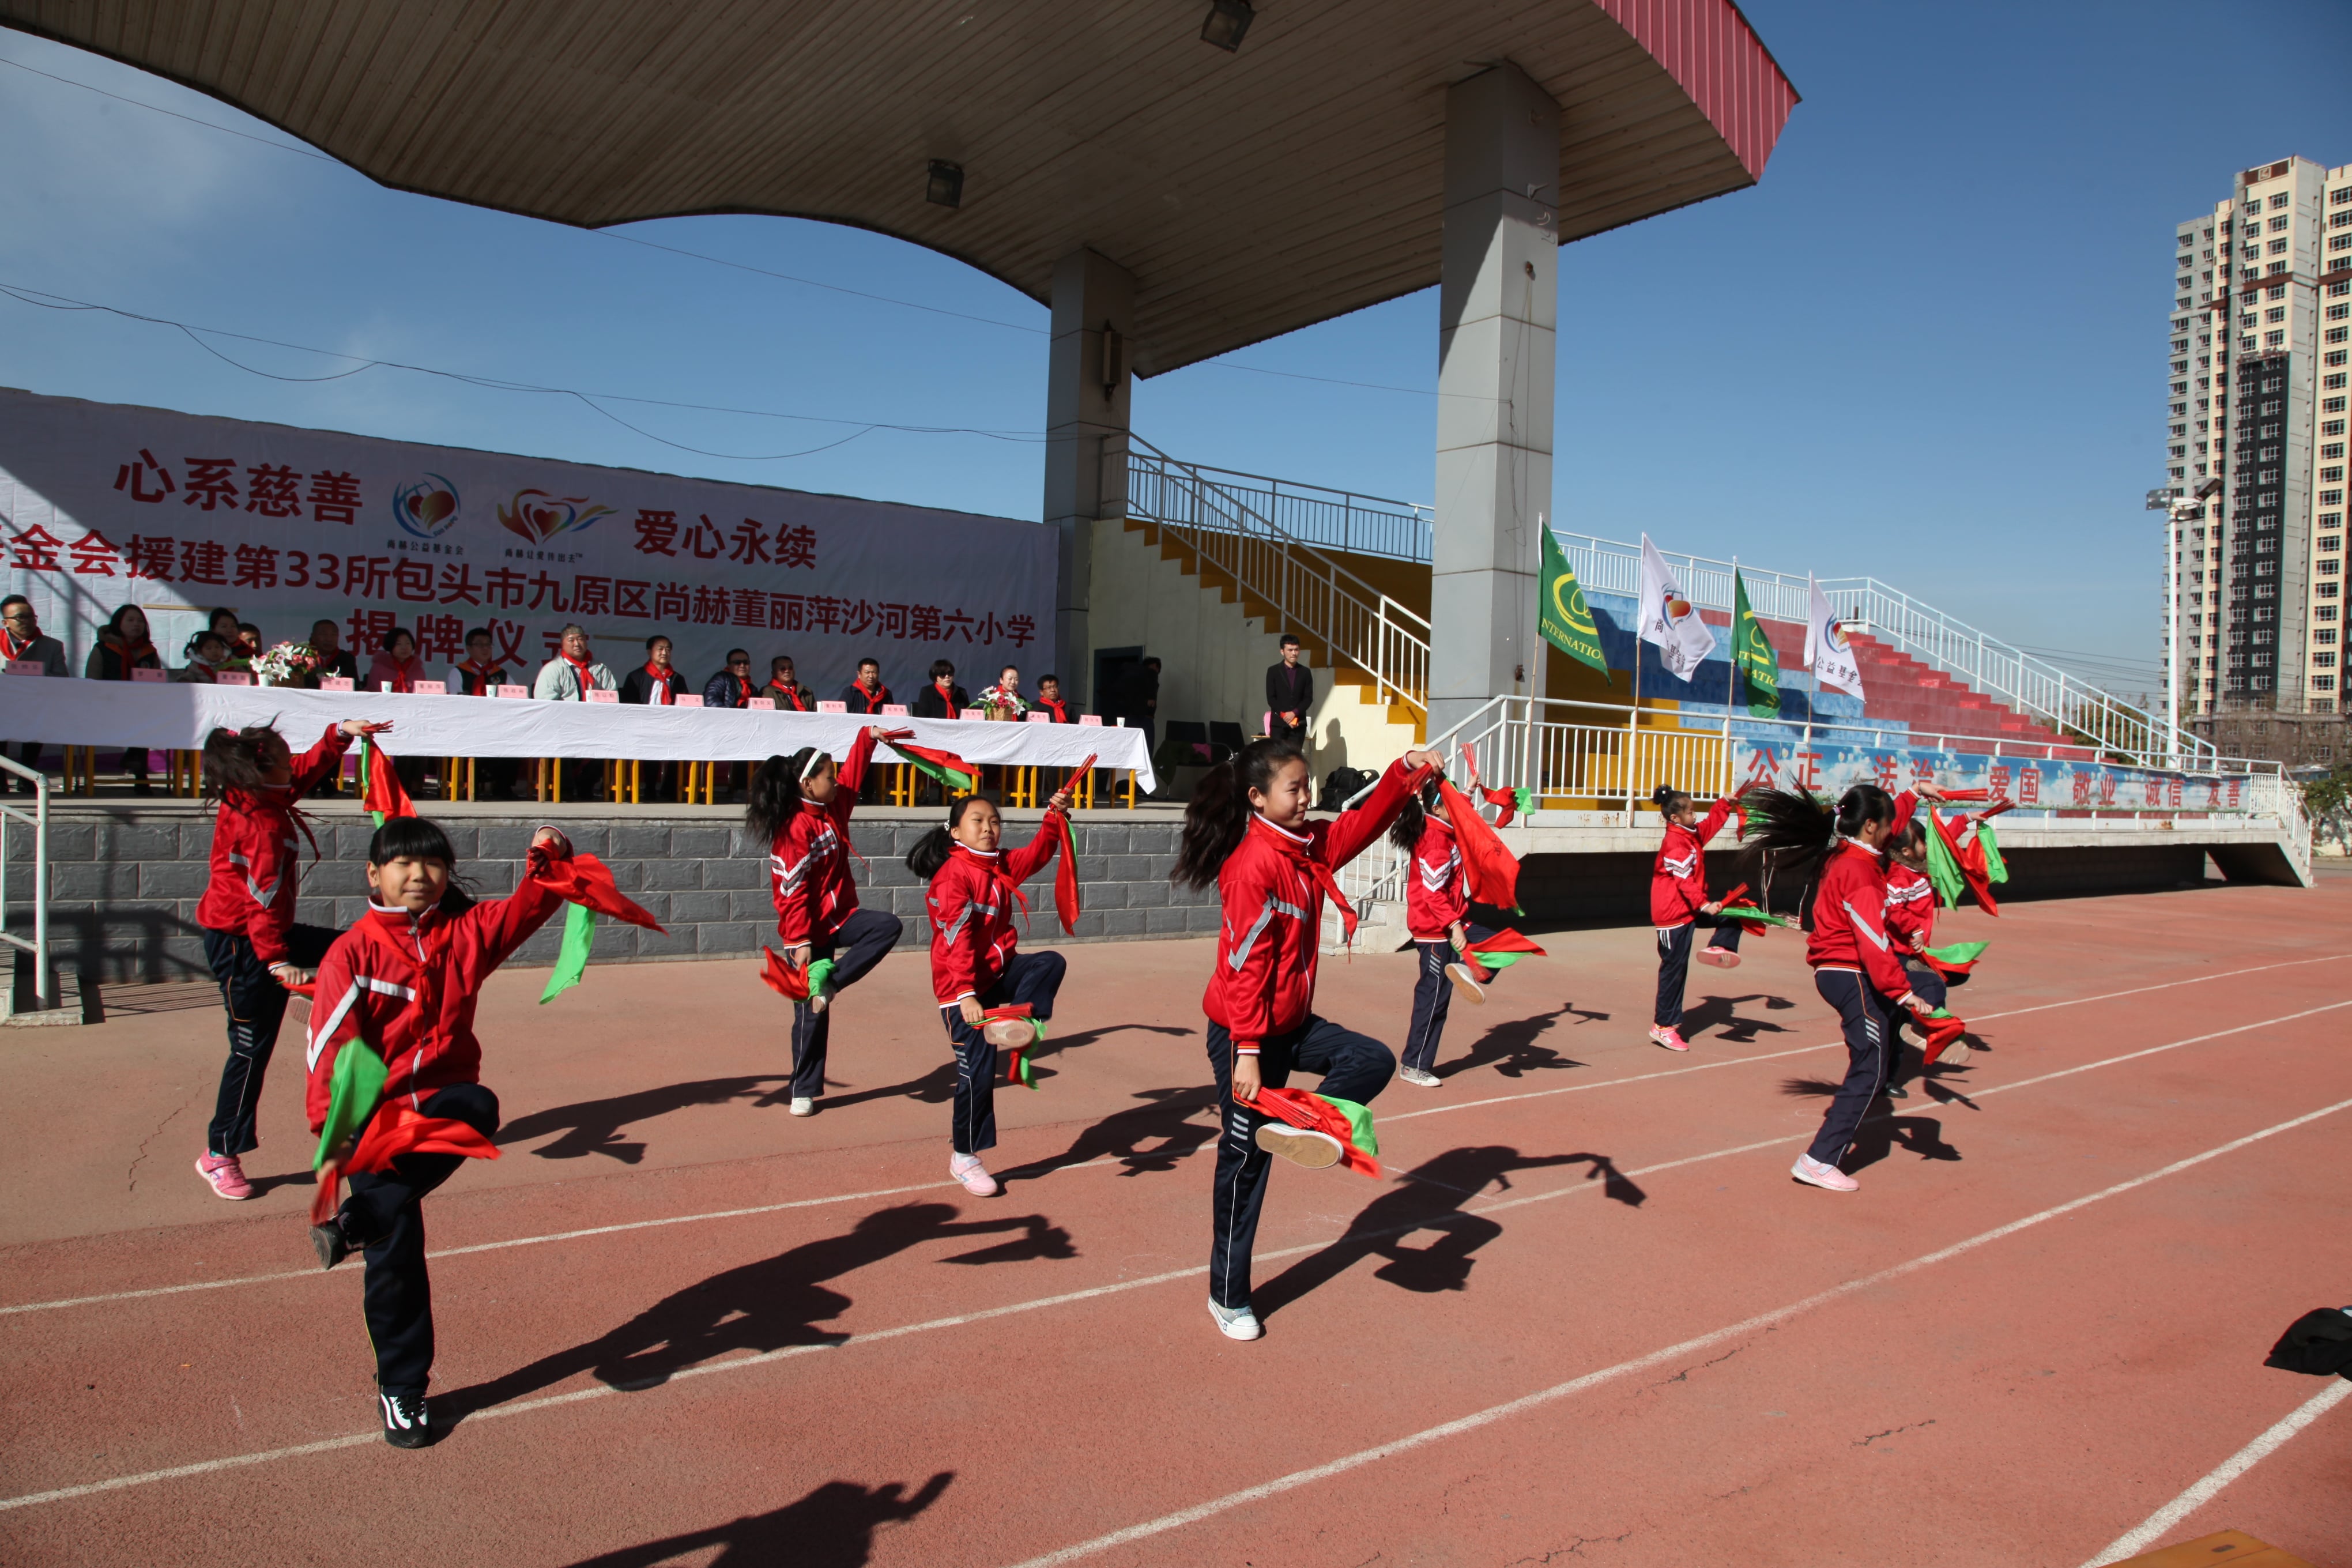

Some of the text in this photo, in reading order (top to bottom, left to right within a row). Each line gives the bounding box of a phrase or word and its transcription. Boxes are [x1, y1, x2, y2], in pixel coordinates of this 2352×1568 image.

[115, 448, 363, 525] 心系慈善
[635, 509, 816, 570] 爱心永续
[0, 523, 1035, 649] 金会援建第33所包头市九原区尚赫董丽萍沙河第六小学
[1747, 748, 2241, 808] 公正 法治 爱国 敬业 诚信 友善
